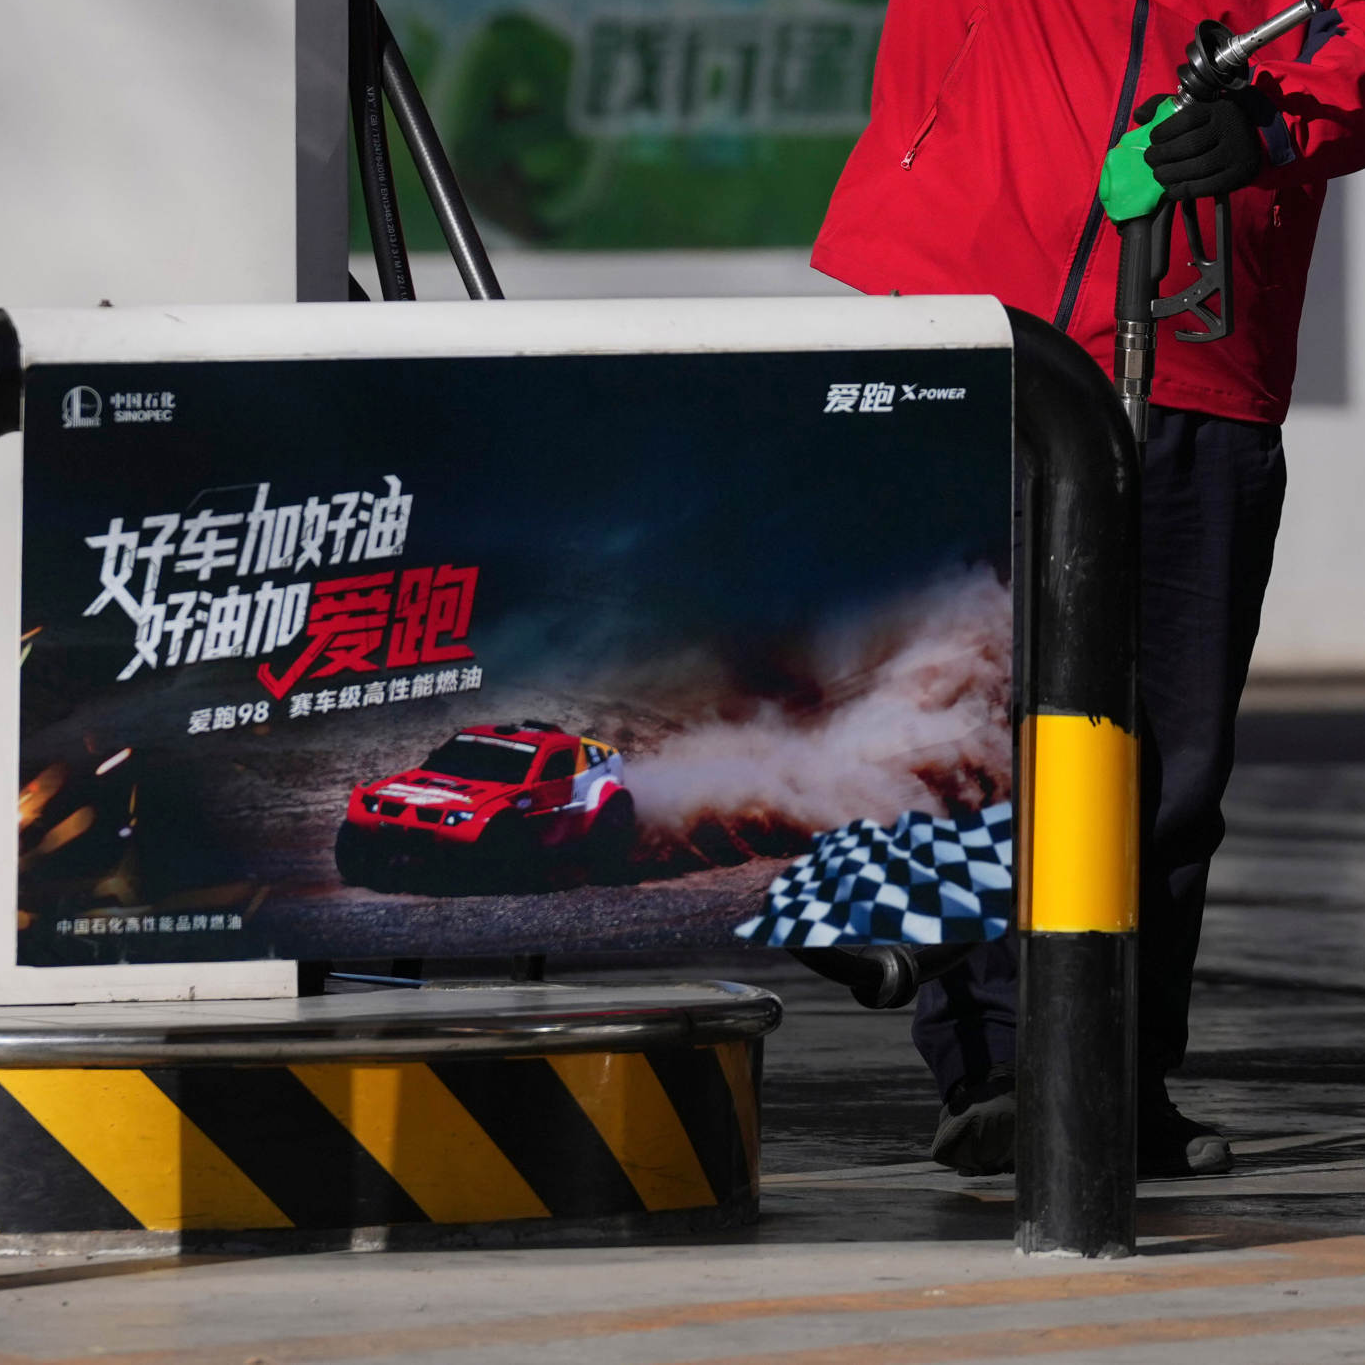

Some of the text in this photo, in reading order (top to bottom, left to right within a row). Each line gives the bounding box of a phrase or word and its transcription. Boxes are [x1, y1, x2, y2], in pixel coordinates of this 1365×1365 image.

[110, 392, 176, 409] 中国石化
[823, 382, 896, 414] 爱跑
[114, 409, 174, 423] SINOPEC
[82, 474, 414, 618] 好车加好油
[187, 665, 483, 735] 爱跑98 赛车级高性能燃油
[56, 914, 243, 935] 中国石化高性能品牌燃油
